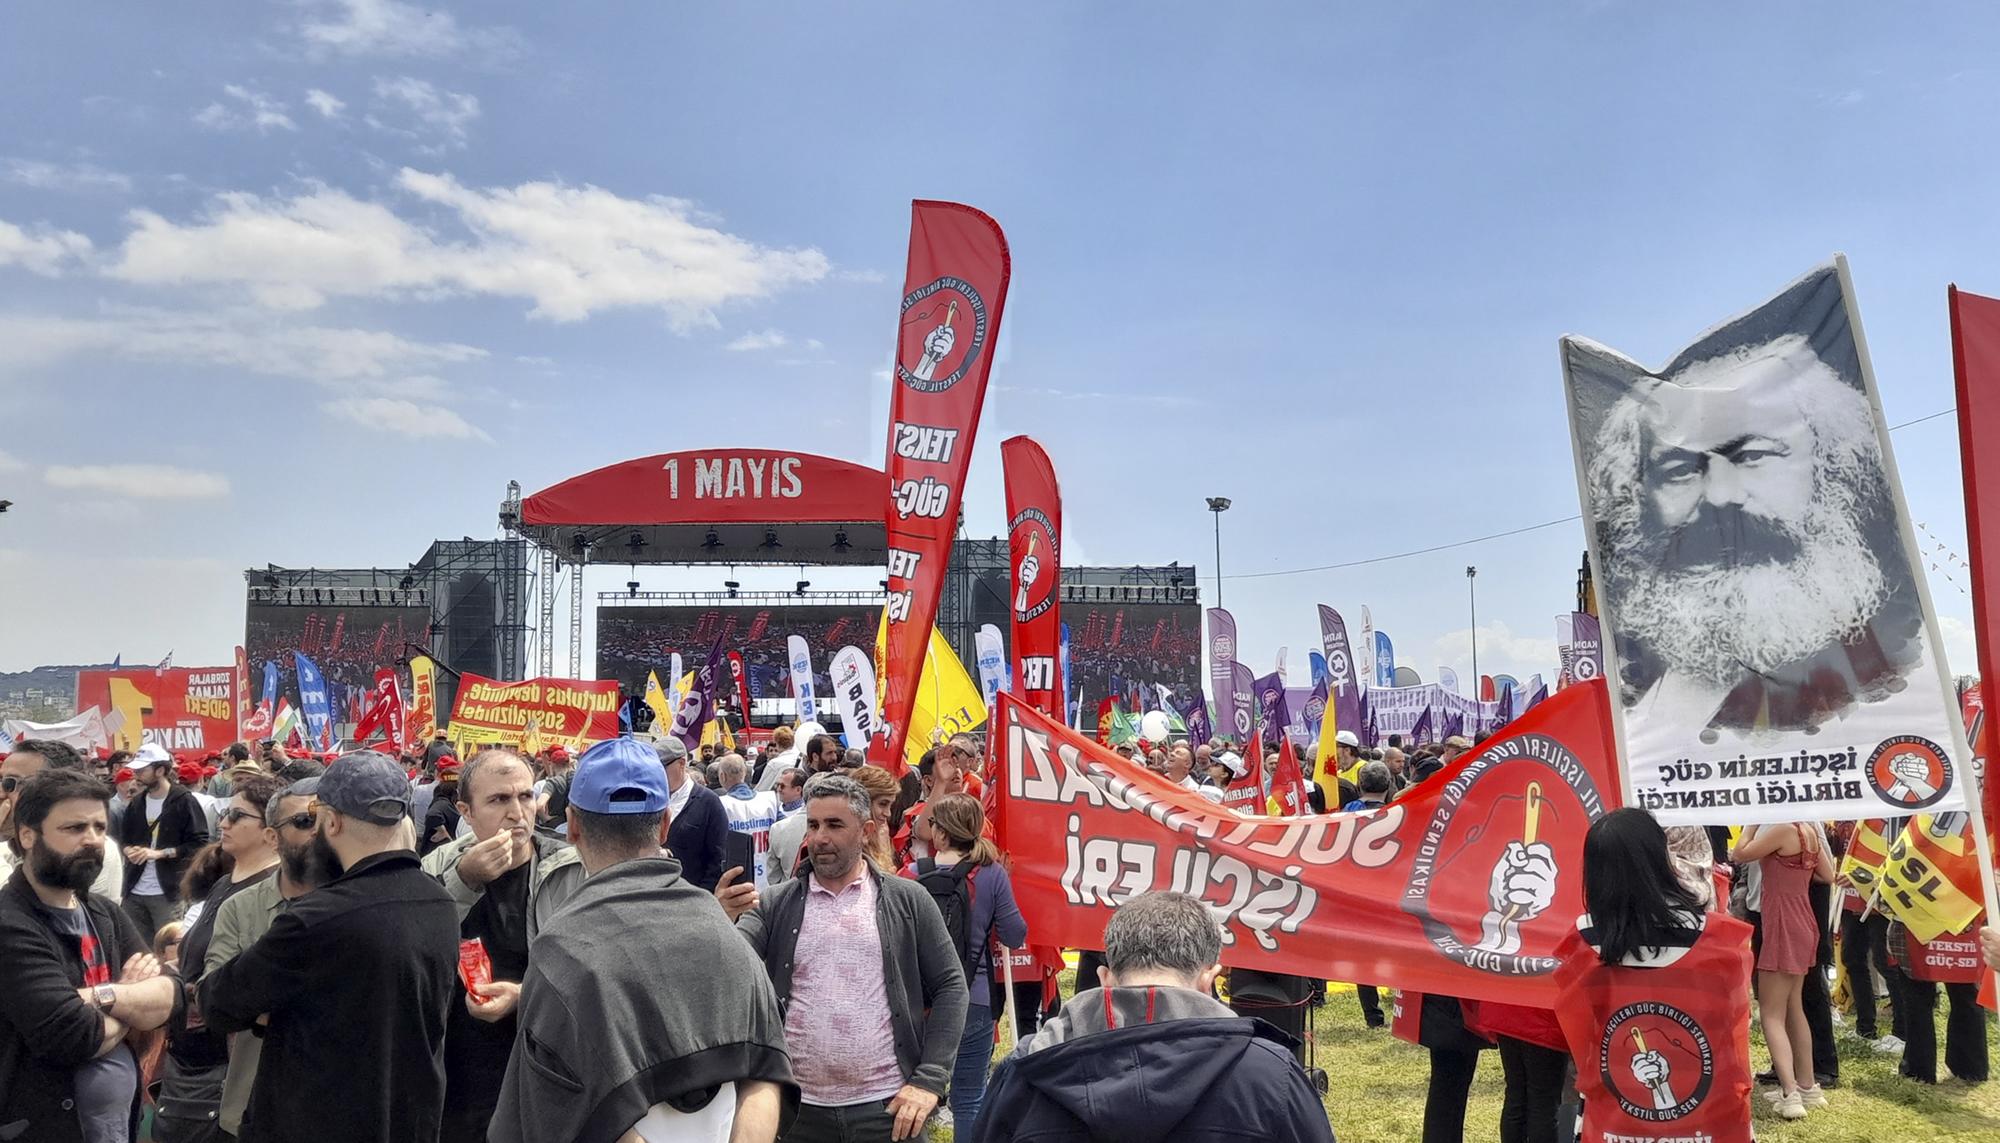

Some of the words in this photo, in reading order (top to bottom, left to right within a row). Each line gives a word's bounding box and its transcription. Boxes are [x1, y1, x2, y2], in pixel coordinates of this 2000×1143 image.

[663, 457, 679, 499] 1
[694, 457, 802, 498] MAYIS
[1690, 1026, 1713, 1075] SENDİKASI
[1619, 1098, 1655, 1121] TEKSTİL
[1658, 1096, 1700, 1121] GÜÇ-SEN
